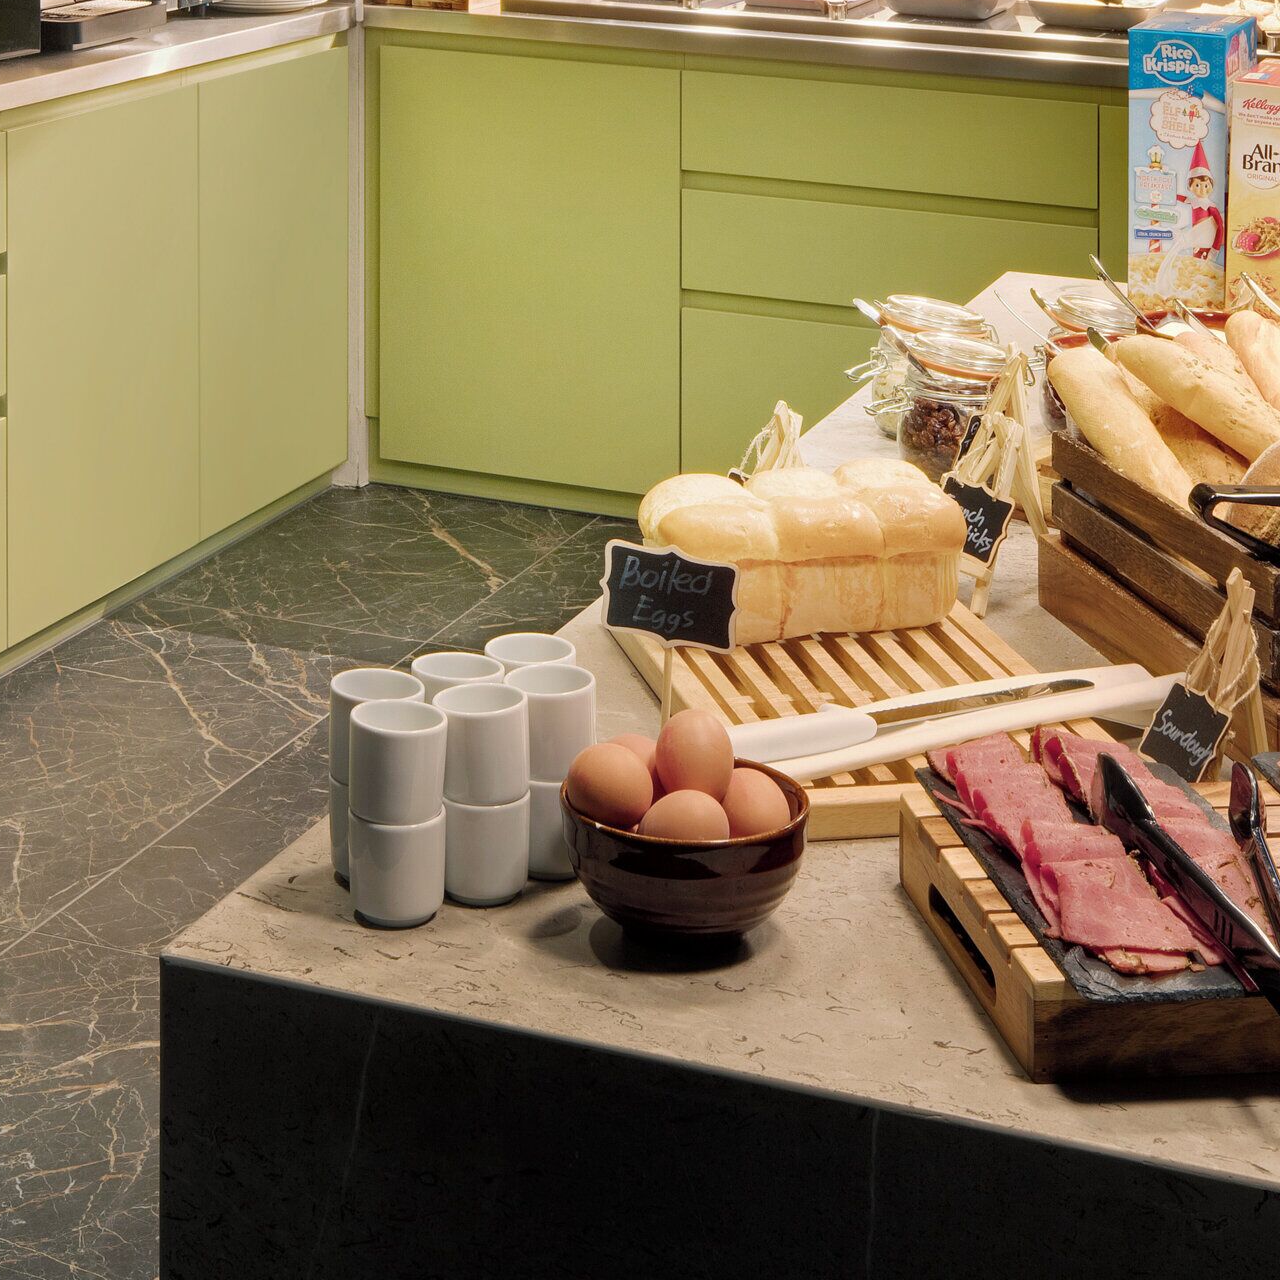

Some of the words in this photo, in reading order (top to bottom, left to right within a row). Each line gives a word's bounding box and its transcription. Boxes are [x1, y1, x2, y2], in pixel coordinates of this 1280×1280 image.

[1160, 44, 1193, 60] Rice
[1145, 57, 1208, 75] Krispies
[1251, 143, 1279, 160] All-
[1246, 173, 1278, 182] ORIGINAL
[619, 555, 714, 596] Boiled
[632, 594, 695, 634] Eggs
[1152, 709, 1213, 767] Sourdough
